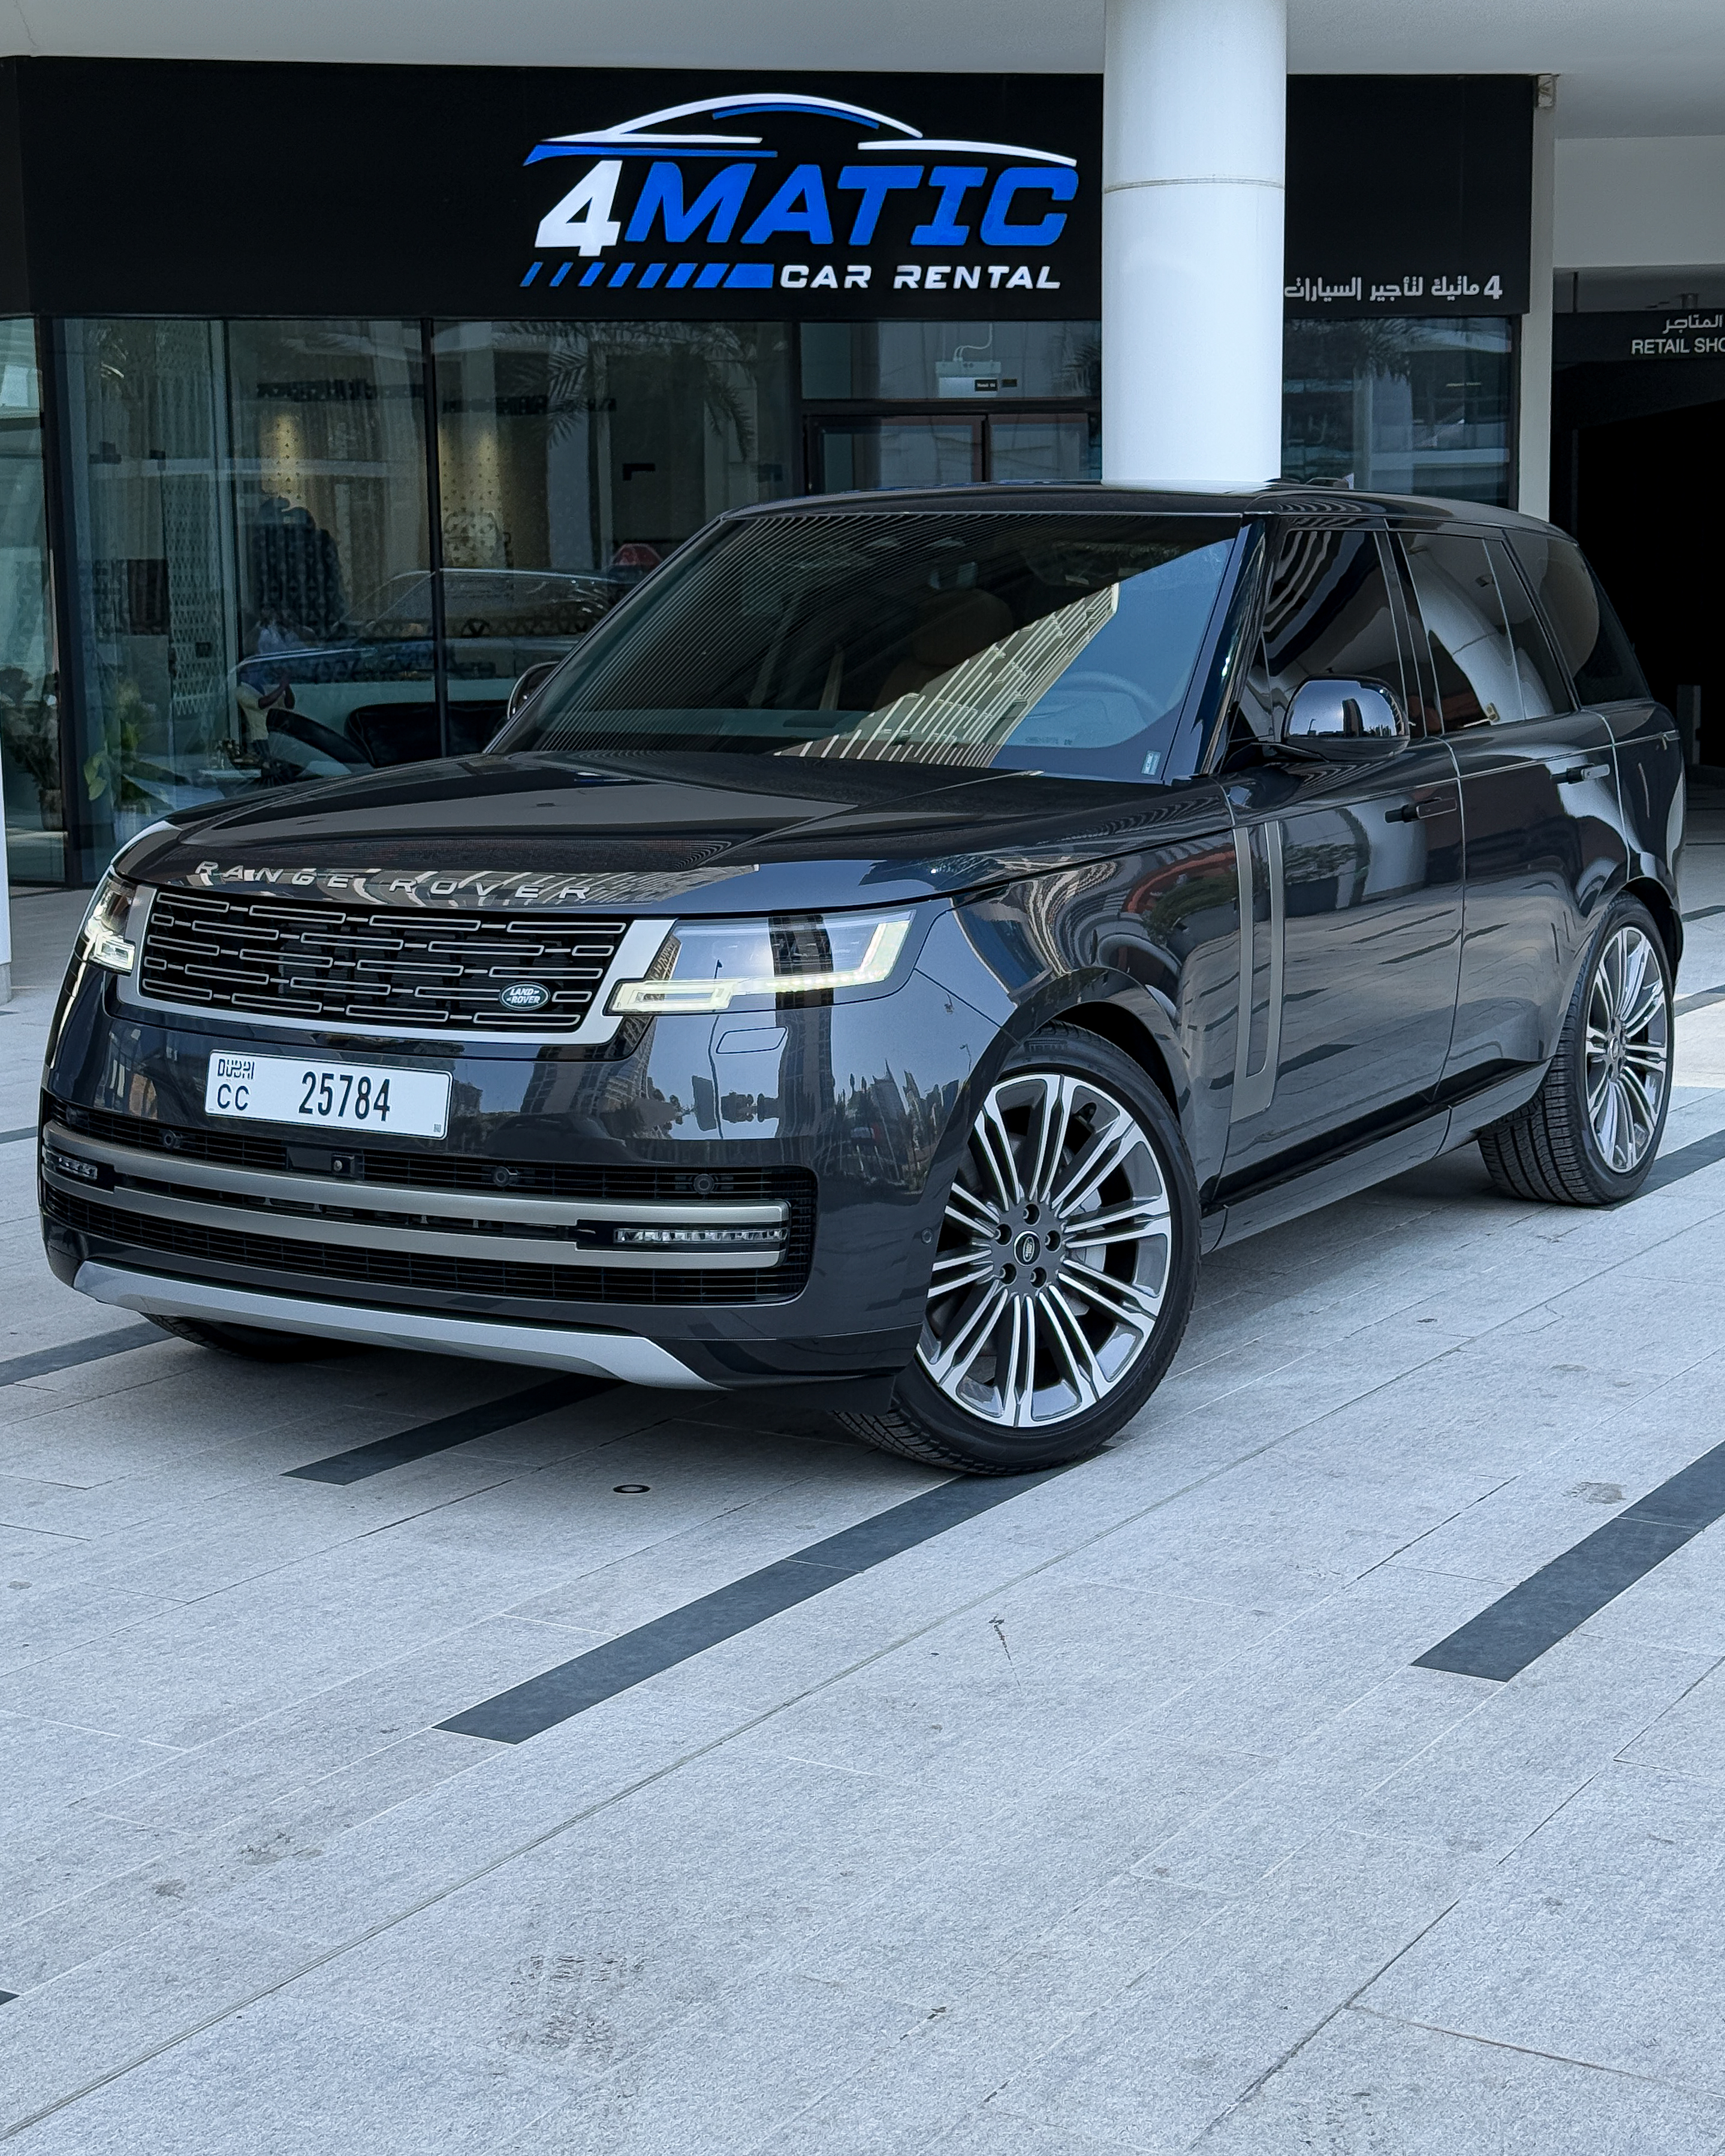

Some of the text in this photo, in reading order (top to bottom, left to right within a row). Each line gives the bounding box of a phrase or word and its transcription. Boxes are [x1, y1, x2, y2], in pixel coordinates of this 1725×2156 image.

[535, 160, 1079, 257] 4MATIC
[780, 265, 1061, 290] CAR RENTAL
[1284, 276, 1361, 301] السيارات
[1370, 276, 1423, 301] لتأجير
[1662, 314, 1723, 334] المتاجر
[1631, 338, 1690, 355] RETAIL
[195, 861, 591, 900] RANGE ROVER
[509, 988, 535, 996] LAND
[511, 996, 541, 1004] ROVER
[218, 1083, 250, 1111] CC
[298, 1071, 391, 1122] 25784
